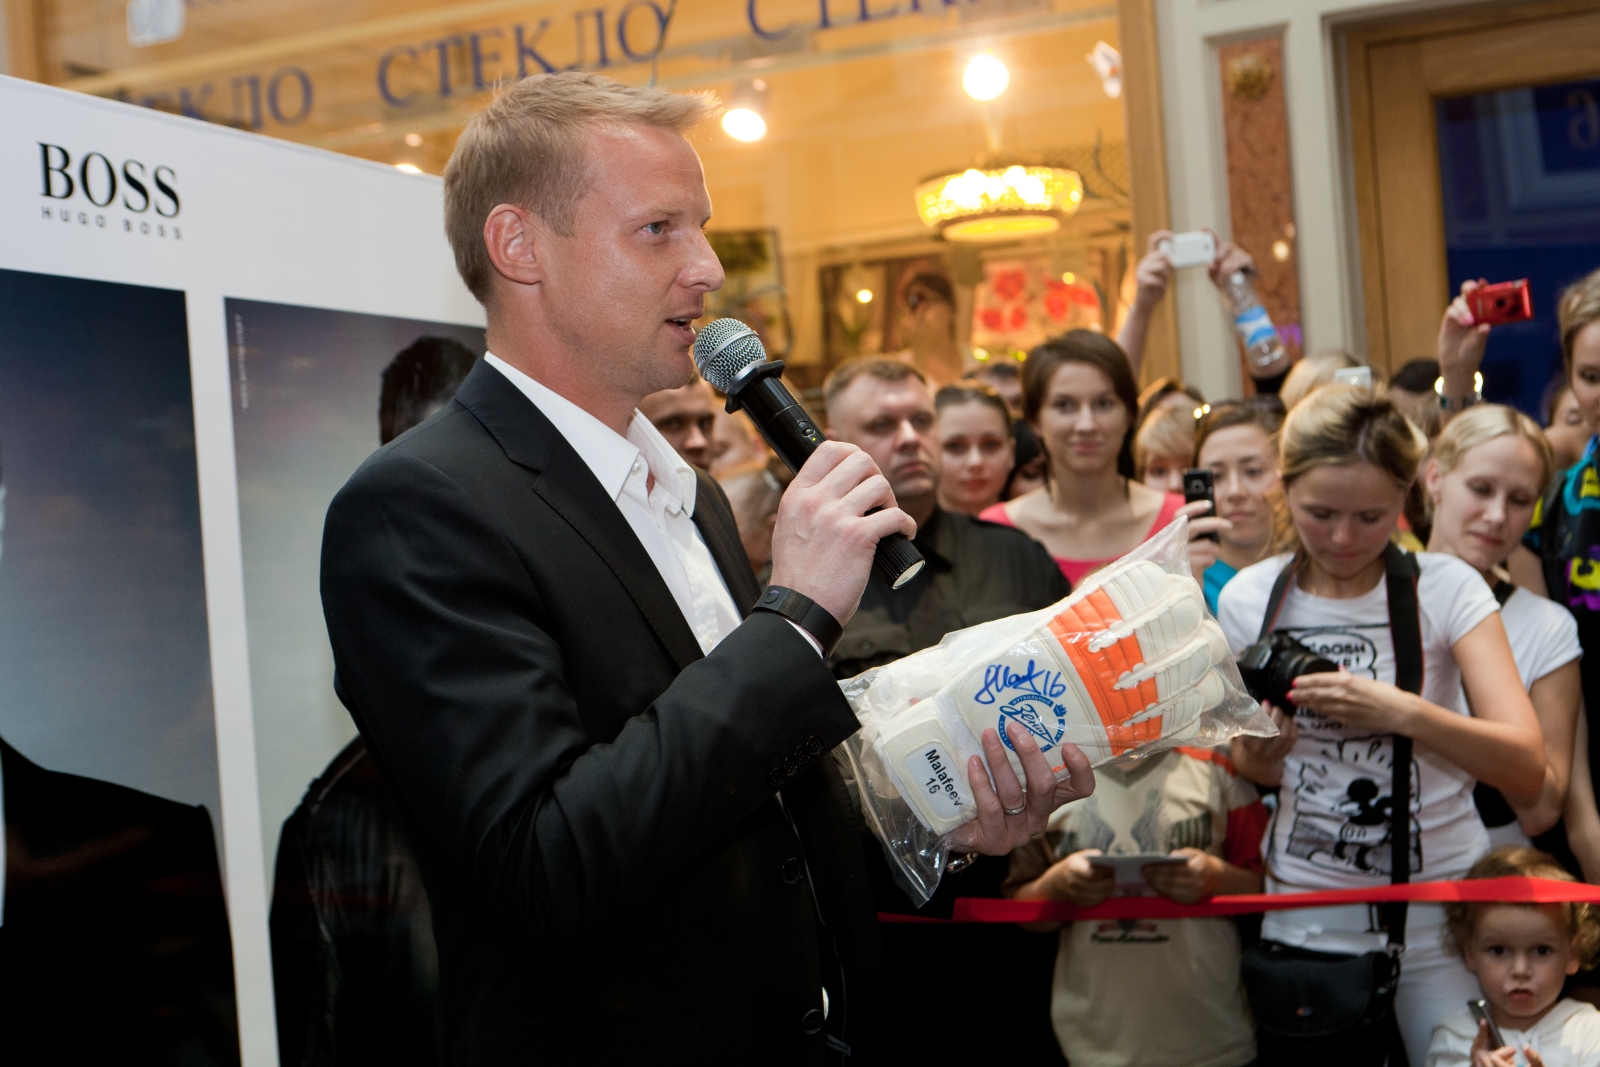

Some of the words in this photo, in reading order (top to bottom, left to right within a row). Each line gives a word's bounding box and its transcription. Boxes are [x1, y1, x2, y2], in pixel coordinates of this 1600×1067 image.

[376, 0, 667, 109] СТЕКЛО
[37, 141, 180, 218] BOSS
[41, 206, 106, 229] HUGO
[123, 218, 182, 240] BOSS
[925, 749, 963, 806] Malafeev
[925, 777, 941, 795] 16
